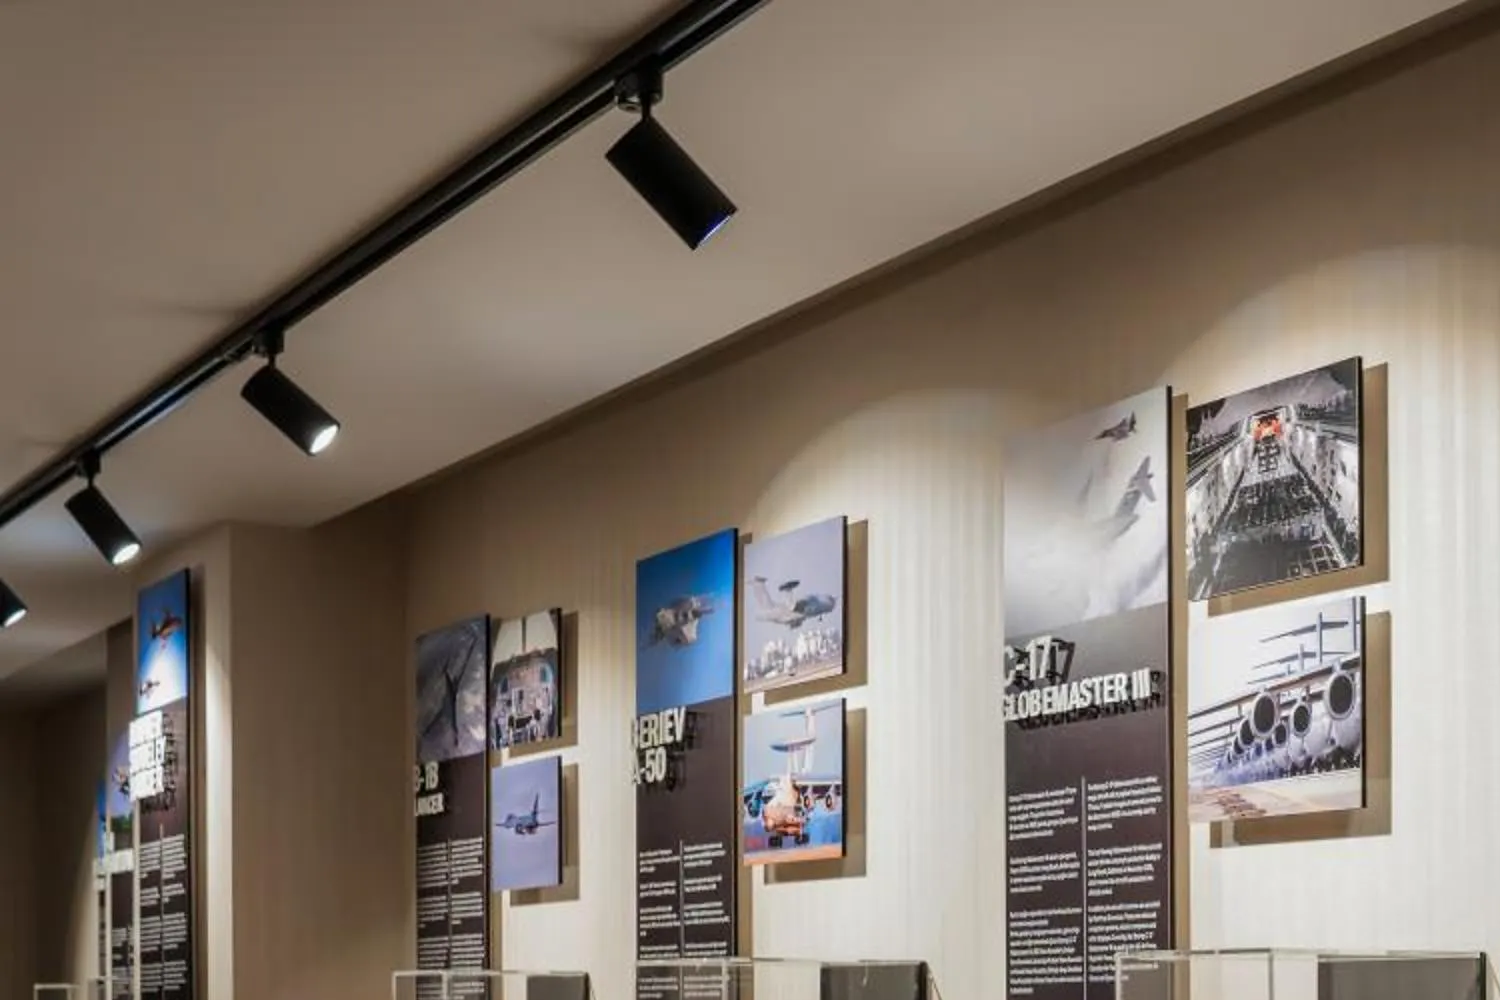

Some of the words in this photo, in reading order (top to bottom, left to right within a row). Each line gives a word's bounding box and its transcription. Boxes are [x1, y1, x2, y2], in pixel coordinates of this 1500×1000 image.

[1001, 634, 1052, 687] C-17
[1001, 672, 1127, 722] GLOBEMASTER
[1131, 667, 1151, 700] III
[631, 746, 667, 784] A-50
